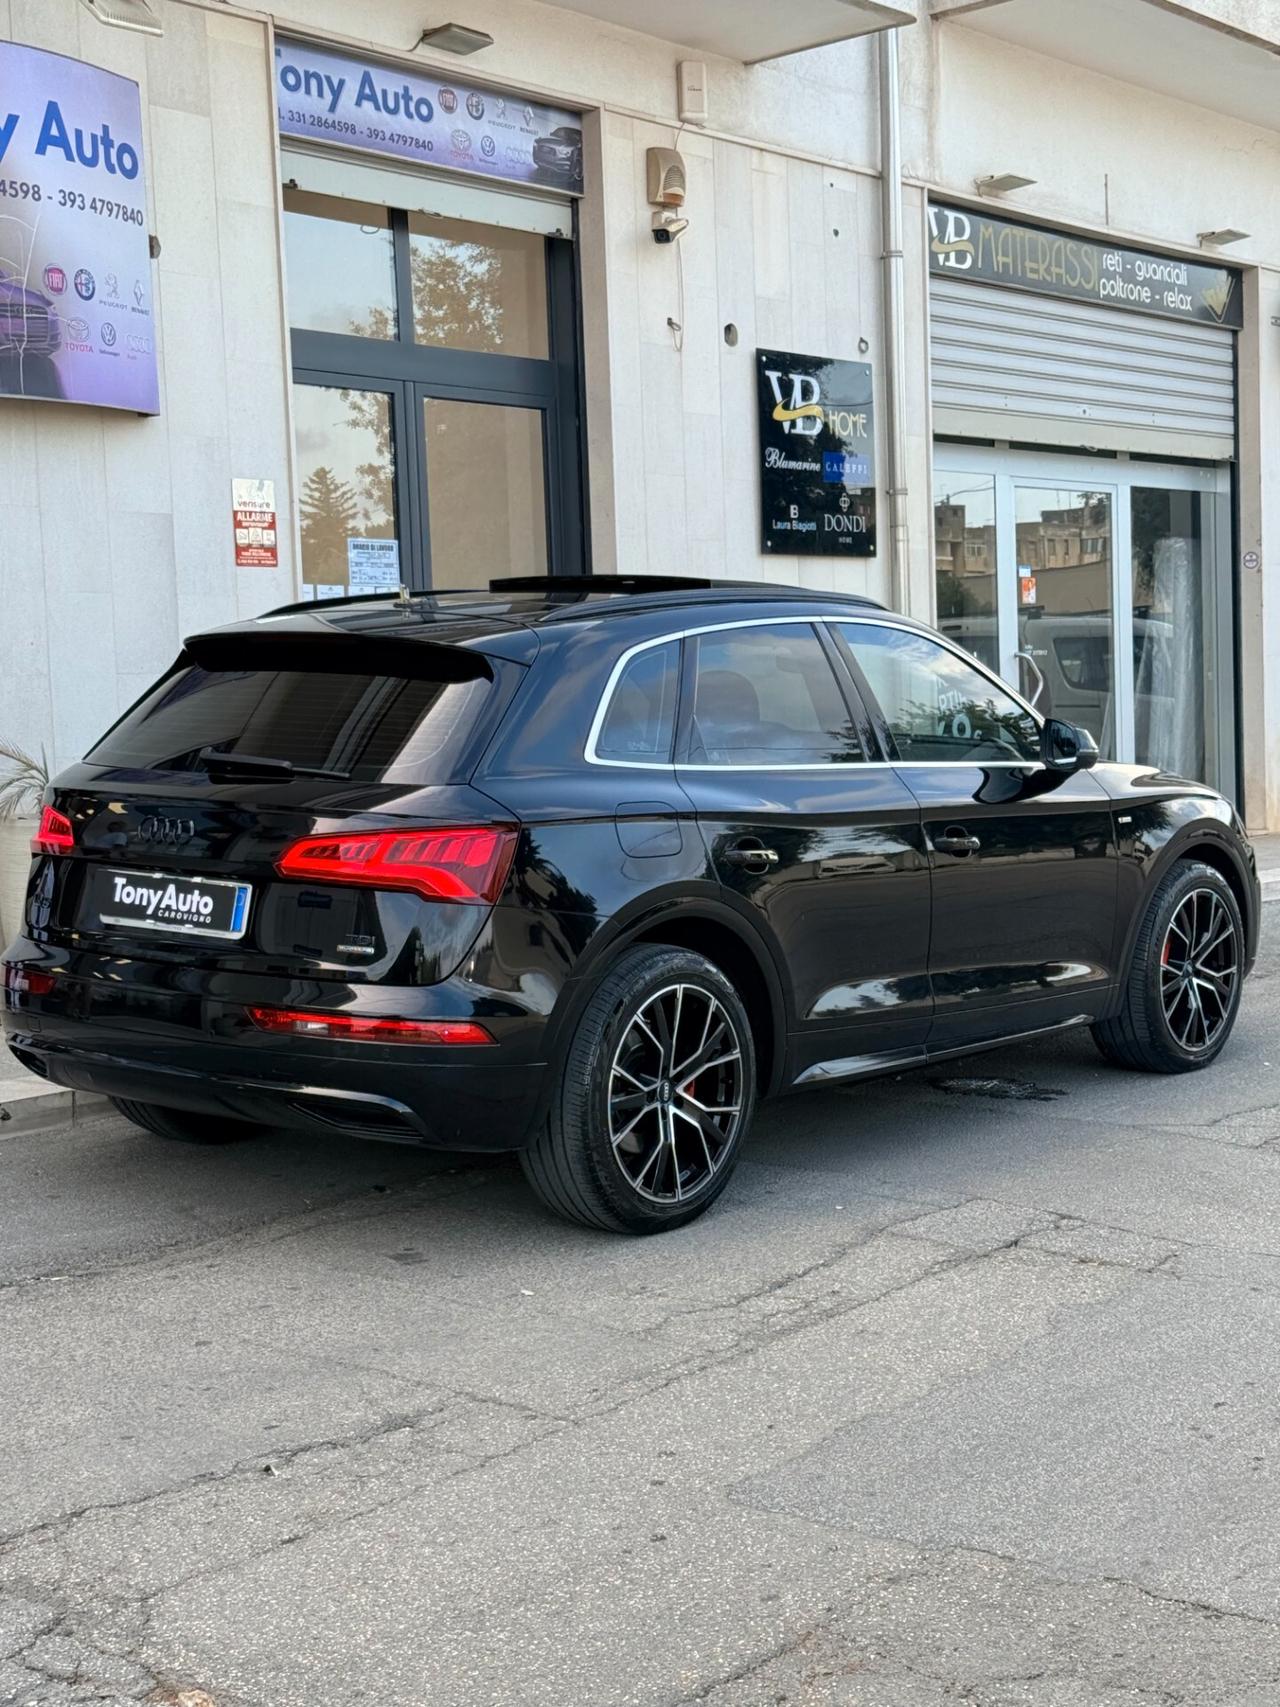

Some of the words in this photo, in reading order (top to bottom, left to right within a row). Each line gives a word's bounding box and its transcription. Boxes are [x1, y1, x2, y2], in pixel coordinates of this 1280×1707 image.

[275, 48, 346, 113] ony
[355, 70, 434, 123] Auto
[34, 99, 139, 180] Auto
[288, 109, 306, 124] 331
[310, 115, 357, 135] 2864598
[366, 127, 386, 141] 393
[388, 133, 434, 152] 4797840
[58, 189, 86, 211] 393
[89, 197, 144, 227] 4797840
[978, 222, 1099, 292] MATERASSI
[1102, 251, 1123, 273] reti
[1135, 259, 1188, 287] guanciali
[48, 271, 64, 293] FIAT
[1100, 274, 1151, 304] poltrone
[1163, 287, 1193, 312] relax
[65, 342, 94, 354] TOYOTA
[765, 370, 824, 437] VB
[829, 409, 868, 440] HOME
[765, 447, 821, 472] Blumarine
[825, 461, 868, 475] CALEFFI
[237, 511, 273, 523] ALLARME
[772, 519, 791, 530] Laura
[824, 513, 867, 533] DONDI
[158, 909, 212, 924] CAROVIGNO
